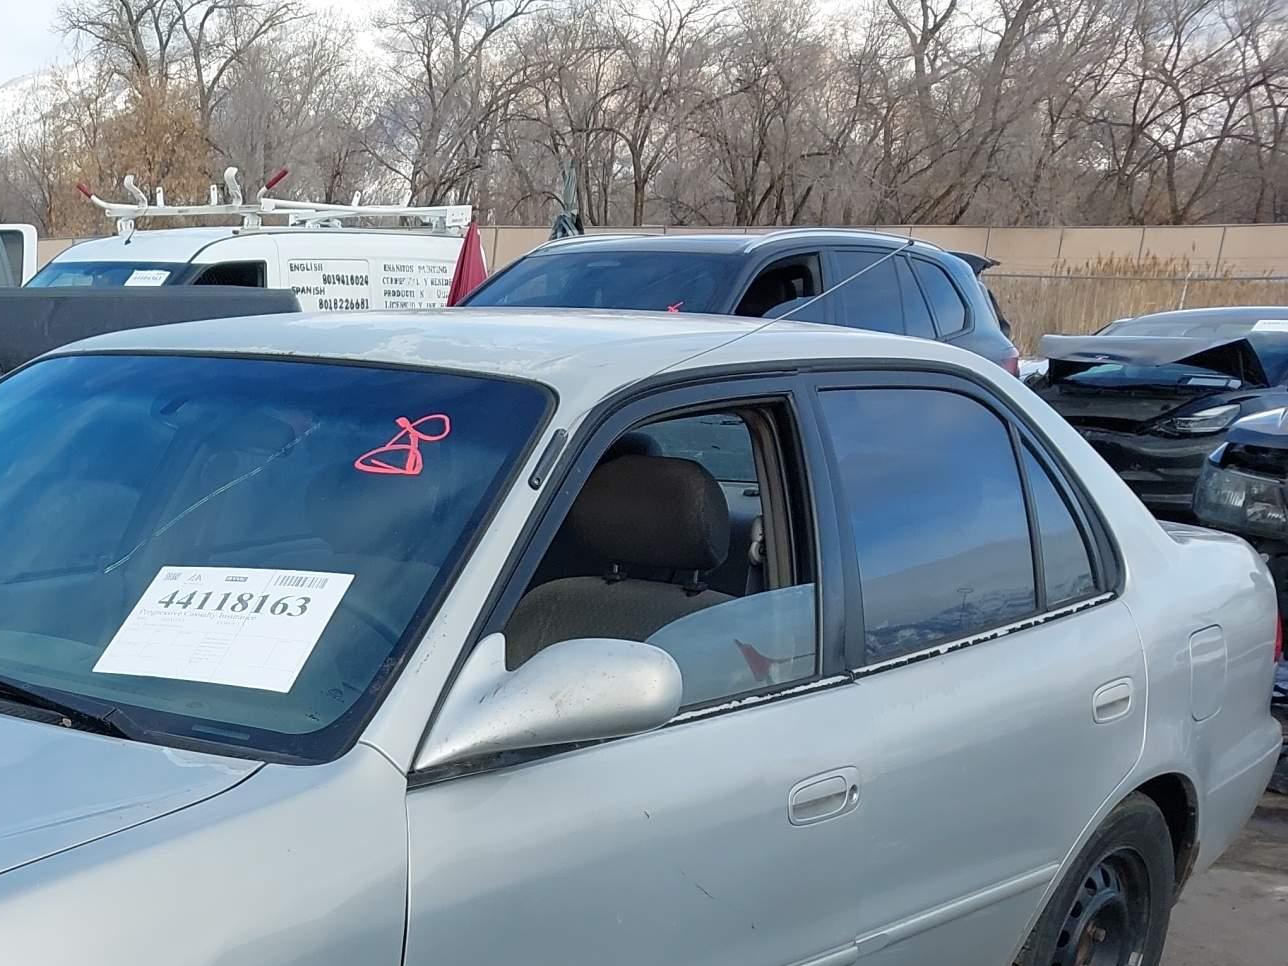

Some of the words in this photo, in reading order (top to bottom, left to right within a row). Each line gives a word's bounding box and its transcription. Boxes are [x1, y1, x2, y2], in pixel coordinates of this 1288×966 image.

[289, 263, 323, 272] ENGLISH
[291, 286, 325, 295] SPANISH
[158, 589, 312, 617] 44118163
